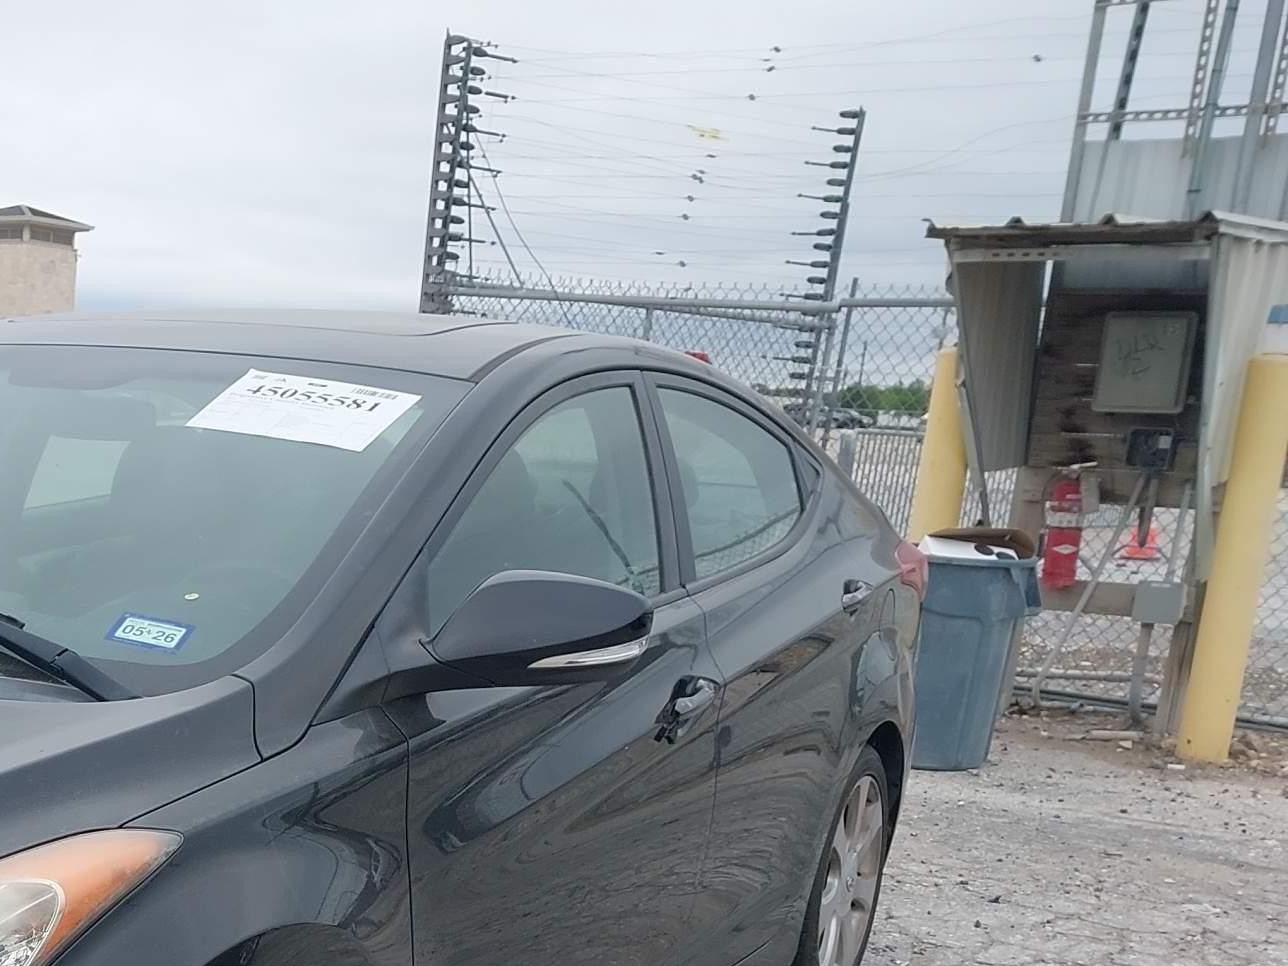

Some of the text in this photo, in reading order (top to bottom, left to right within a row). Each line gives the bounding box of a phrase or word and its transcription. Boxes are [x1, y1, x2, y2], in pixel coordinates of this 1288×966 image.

[246, 384, 382, 412] 45055581
[121, 624, 146, 637] 05
[152, 630, 177, 643] 26
